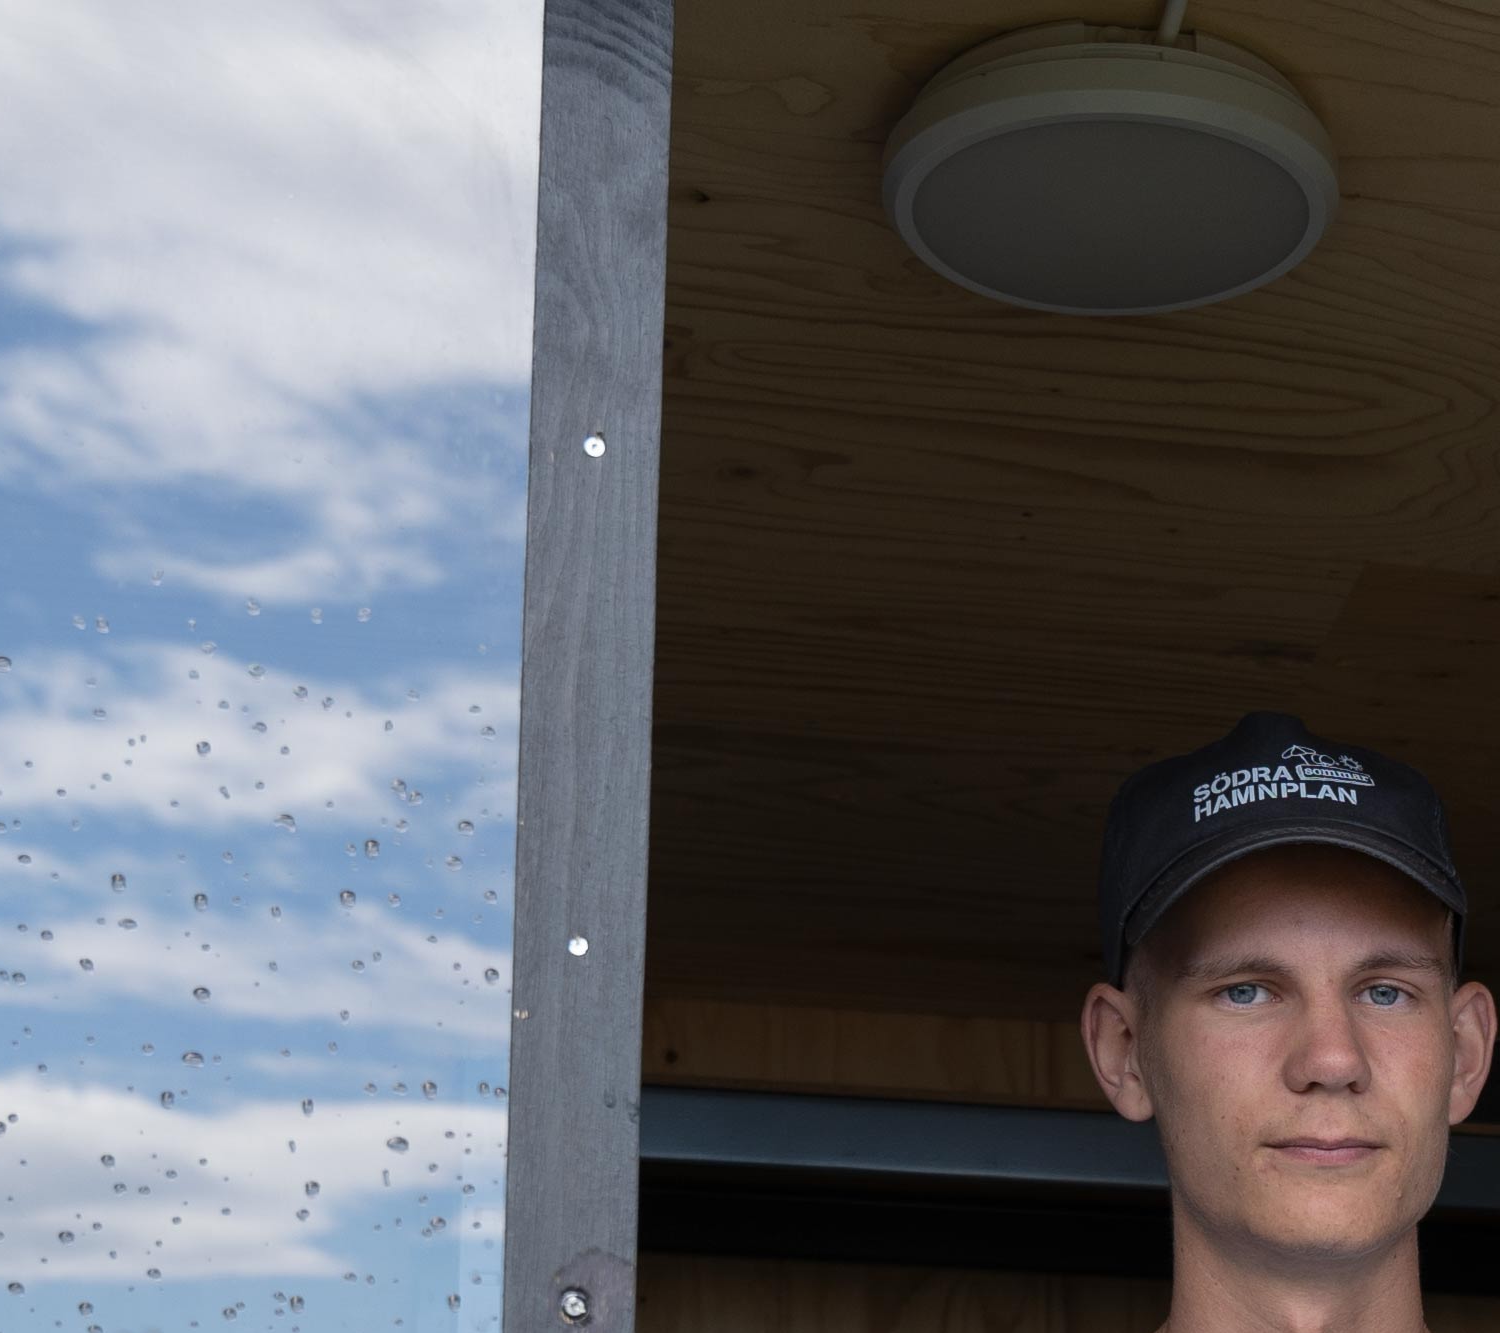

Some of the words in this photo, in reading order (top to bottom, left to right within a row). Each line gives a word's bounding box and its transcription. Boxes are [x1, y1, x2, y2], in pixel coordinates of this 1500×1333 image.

[1192, 764, 1294, 805] SÖDRA
[1303, 765, 1372, 784] sommar
[1193, 782, 1358, 823] HAMNPLAN
